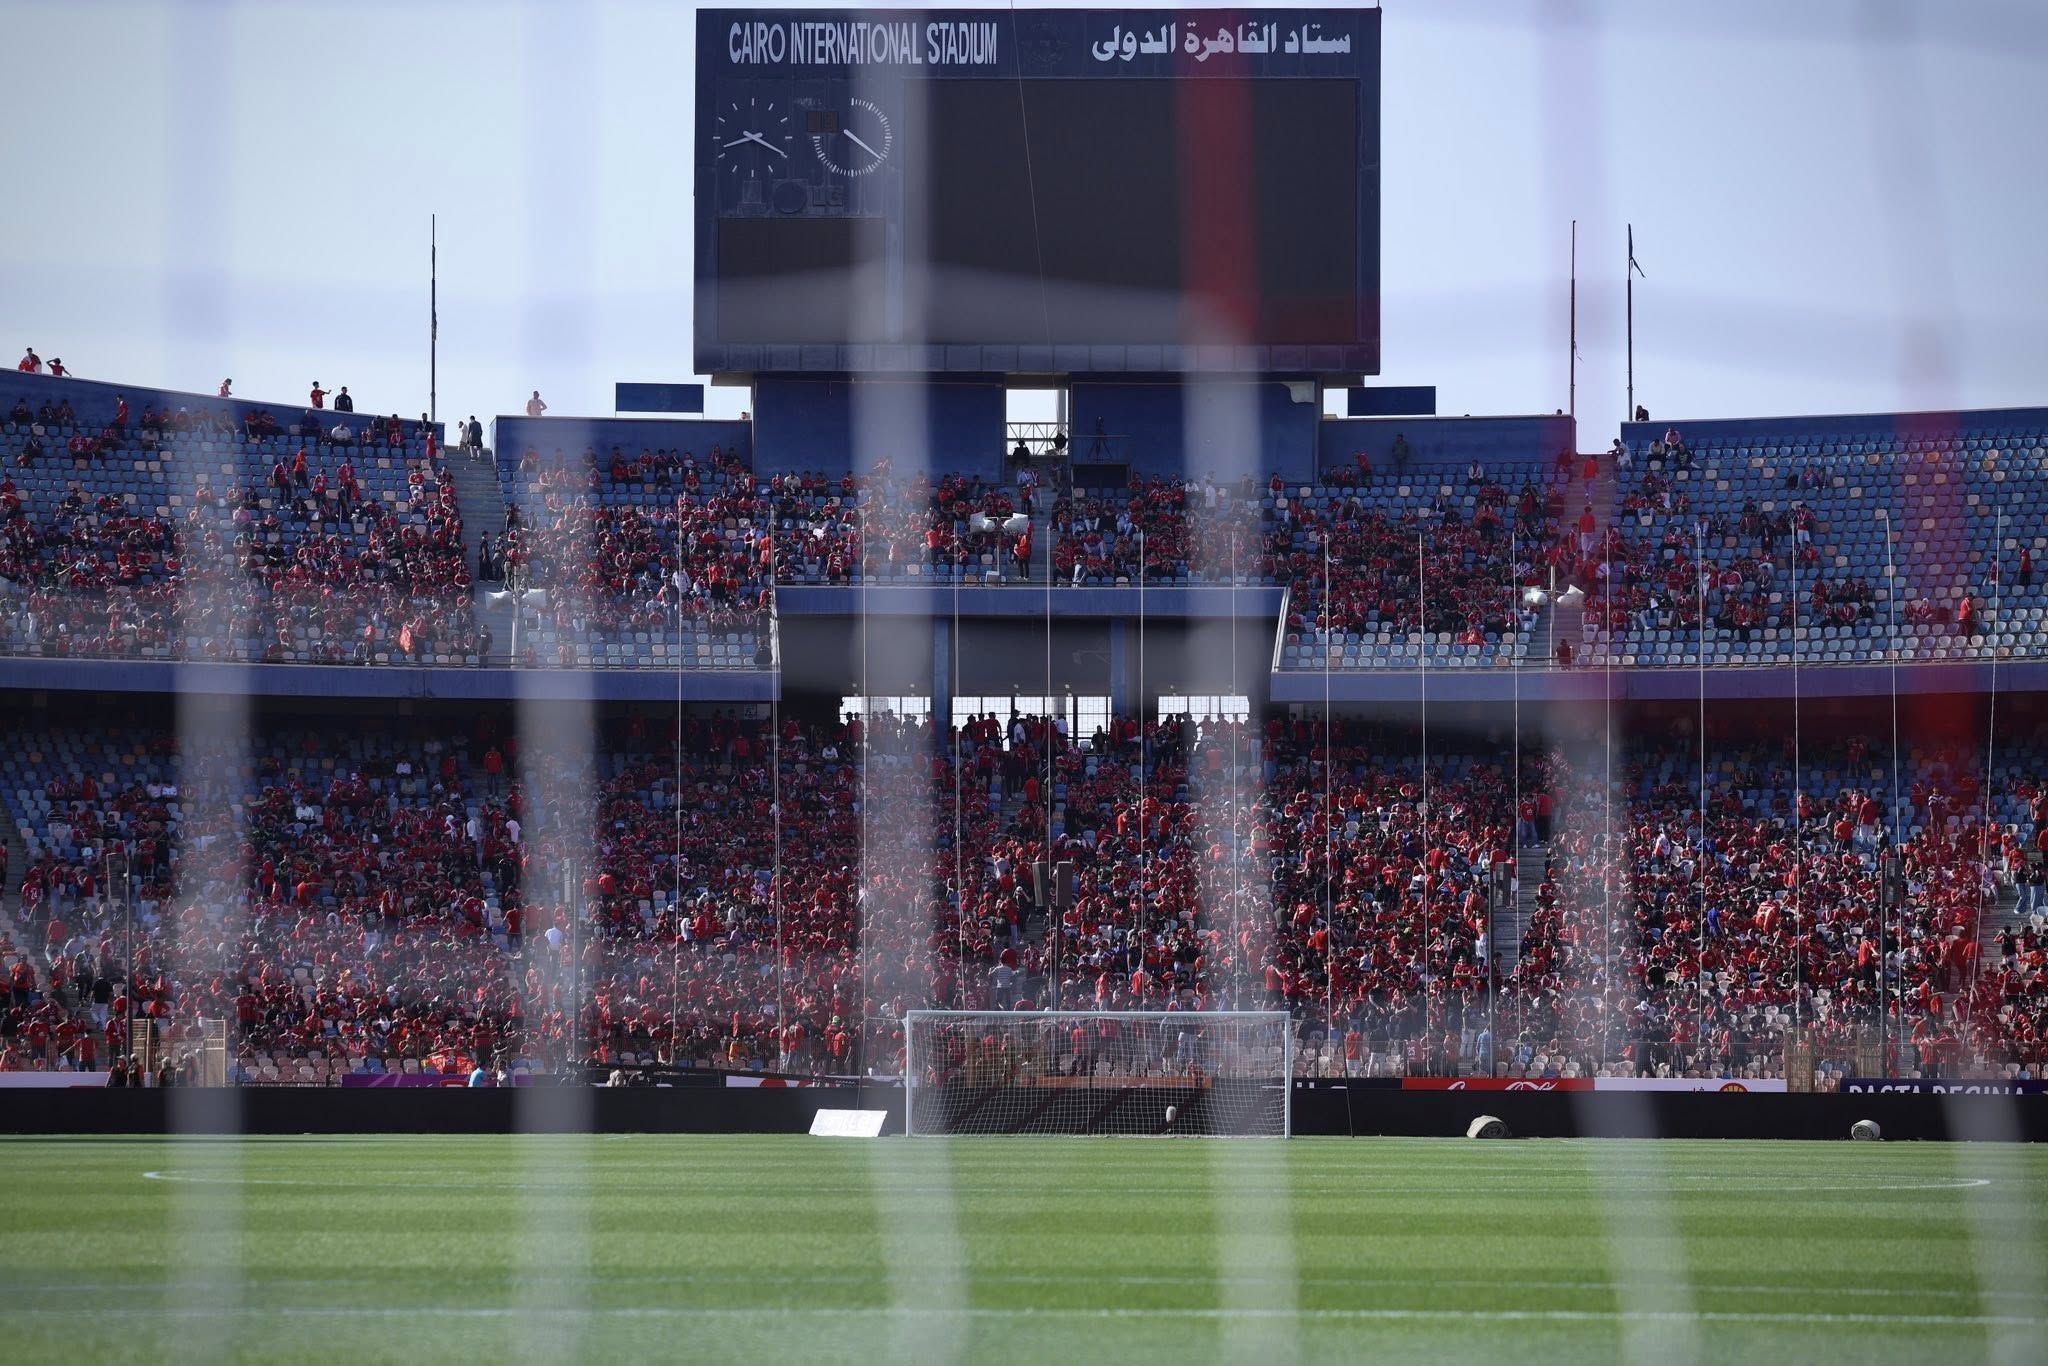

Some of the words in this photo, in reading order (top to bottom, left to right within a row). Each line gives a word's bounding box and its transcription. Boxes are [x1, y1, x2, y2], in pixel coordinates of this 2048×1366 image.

[729, 22, 786, 64] CAIRO
[790, 22, 923, 64] INTERNATIONAL
[926, 22, 997, 65] STADIUM
[1184, 21, 1277, 63] القاهرة
[1284, 23, 1351, 54] ستاد
